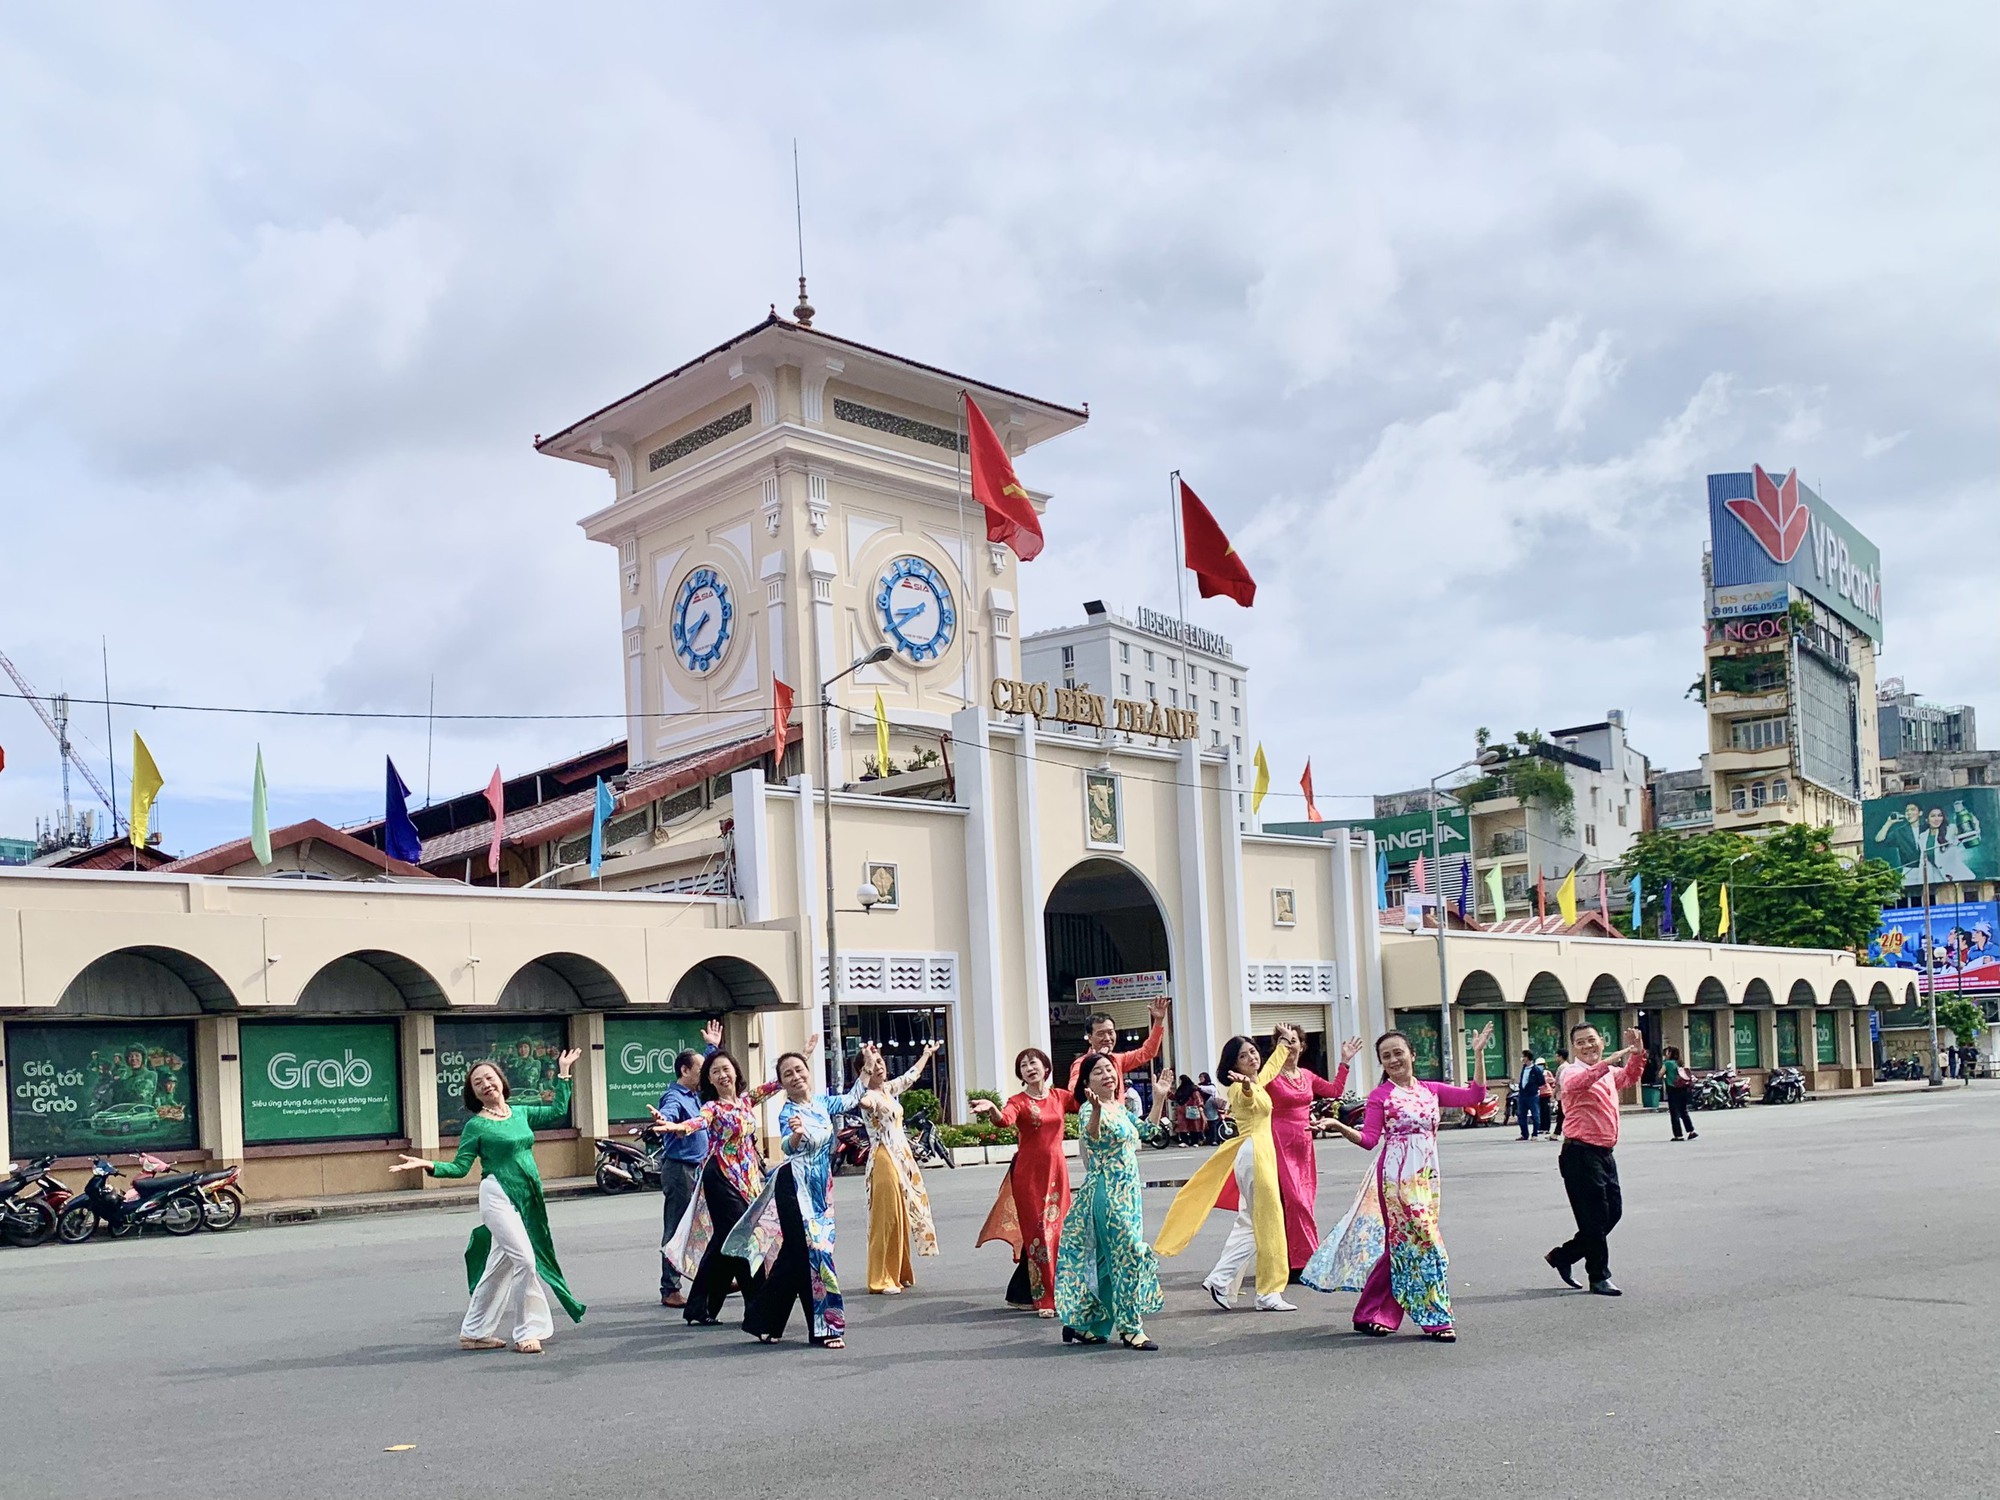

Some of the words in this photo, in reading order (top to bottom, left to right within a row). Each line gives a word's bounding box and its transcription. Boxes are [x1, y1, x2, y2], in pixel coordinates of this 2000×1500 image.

[1809, 512, 1881, 623] VPBank
[877, 593, 889, 609] 9
[1138, 606, 1181, 641] LIBERTY
[1182, 621, 1233, 657] CENTRAL
[991, 678, 1048, 718] CHỢ
[1055, 682, 1106, 727] BẾN
[1113, 698, 1199, 739] THÀNH
[1882, 933, 1903, 947] 2/9
[441, 1051, 464, 1065] Giá
[23, 1060, 54, 1077] Giá
[57, 1068, 84, 1086] tốt
[267, 1049, 372, 1089] Grab
[16, 1079, 58, 1097] chốt
[447, 1083, 466, 1097] Gr
[32, 1096, 78, 1113] Grab
